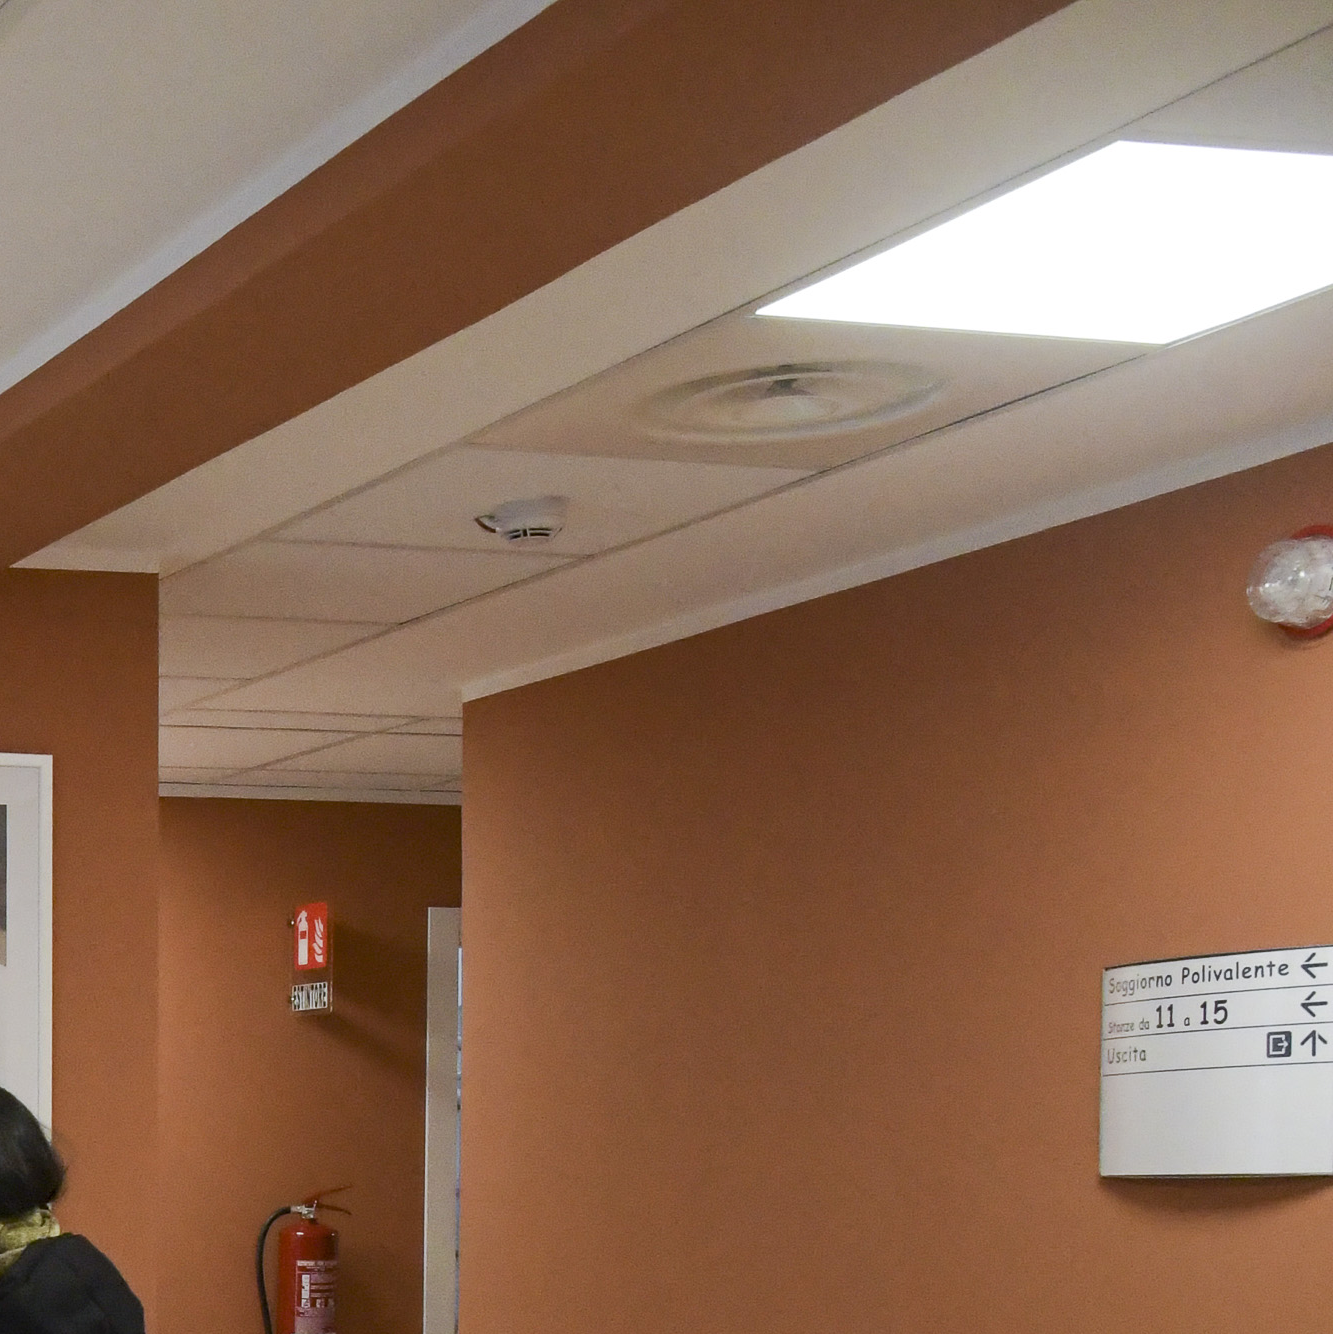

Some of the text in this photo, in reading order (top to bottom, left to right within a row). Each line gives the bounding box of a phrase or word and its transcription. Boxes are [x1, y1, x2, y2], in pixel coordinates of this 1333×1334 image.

[1108, 960, 1290, 997] Soggiorno Polivalente
[1139, 1018, 1150, 1030] da
[1155, 1003, 1175, 1029] 11
[1183, 1016, 1191, 1027] a
[1200, 999, 1229, 1026] 15
[1107, 1046, 1147, 1065] Uscita
